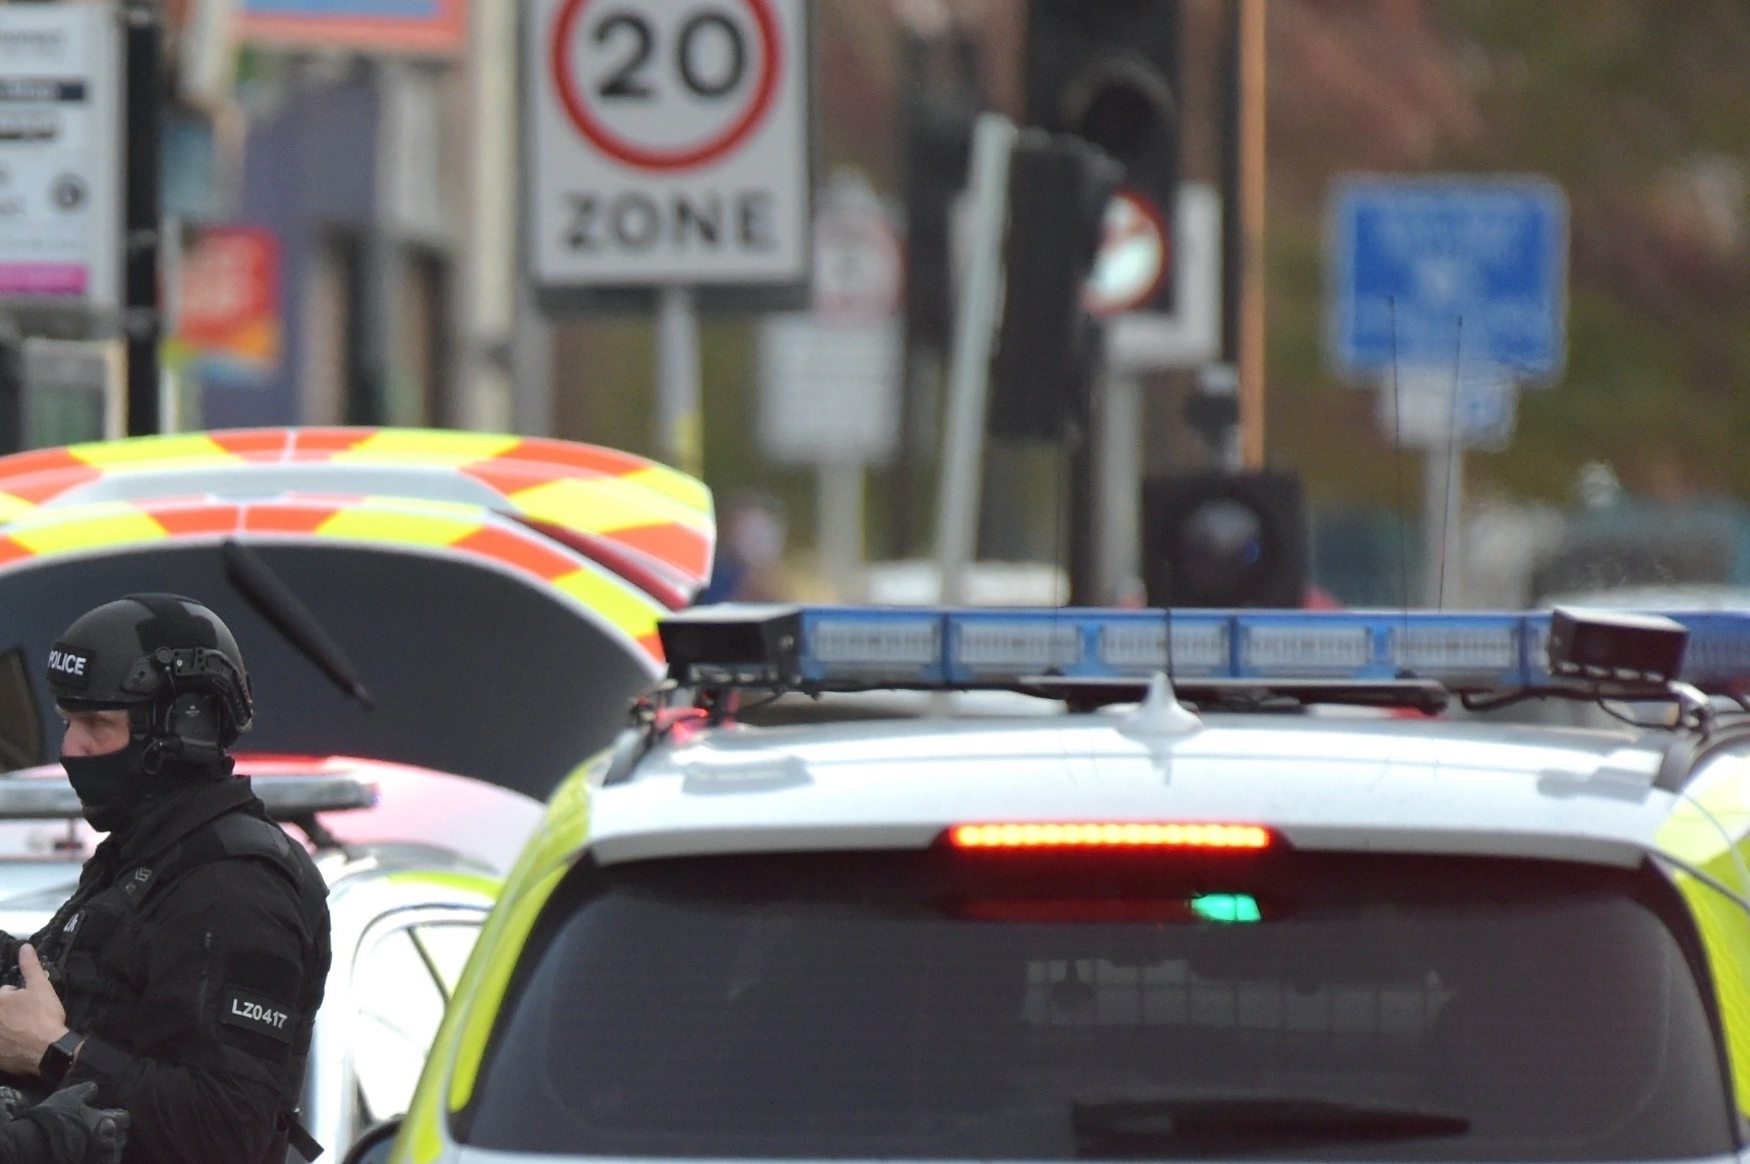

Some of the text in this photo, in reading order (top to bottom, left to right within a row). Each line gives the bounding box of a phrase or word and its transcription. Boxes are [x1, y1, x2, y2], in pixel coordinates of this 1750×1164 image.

[592, 12, 747, 99] 20
[563, 188, 780, 248] ZONE
[47, 650, 86, 676] POLICE
[231, 998, 288, 1030] LZ0417
